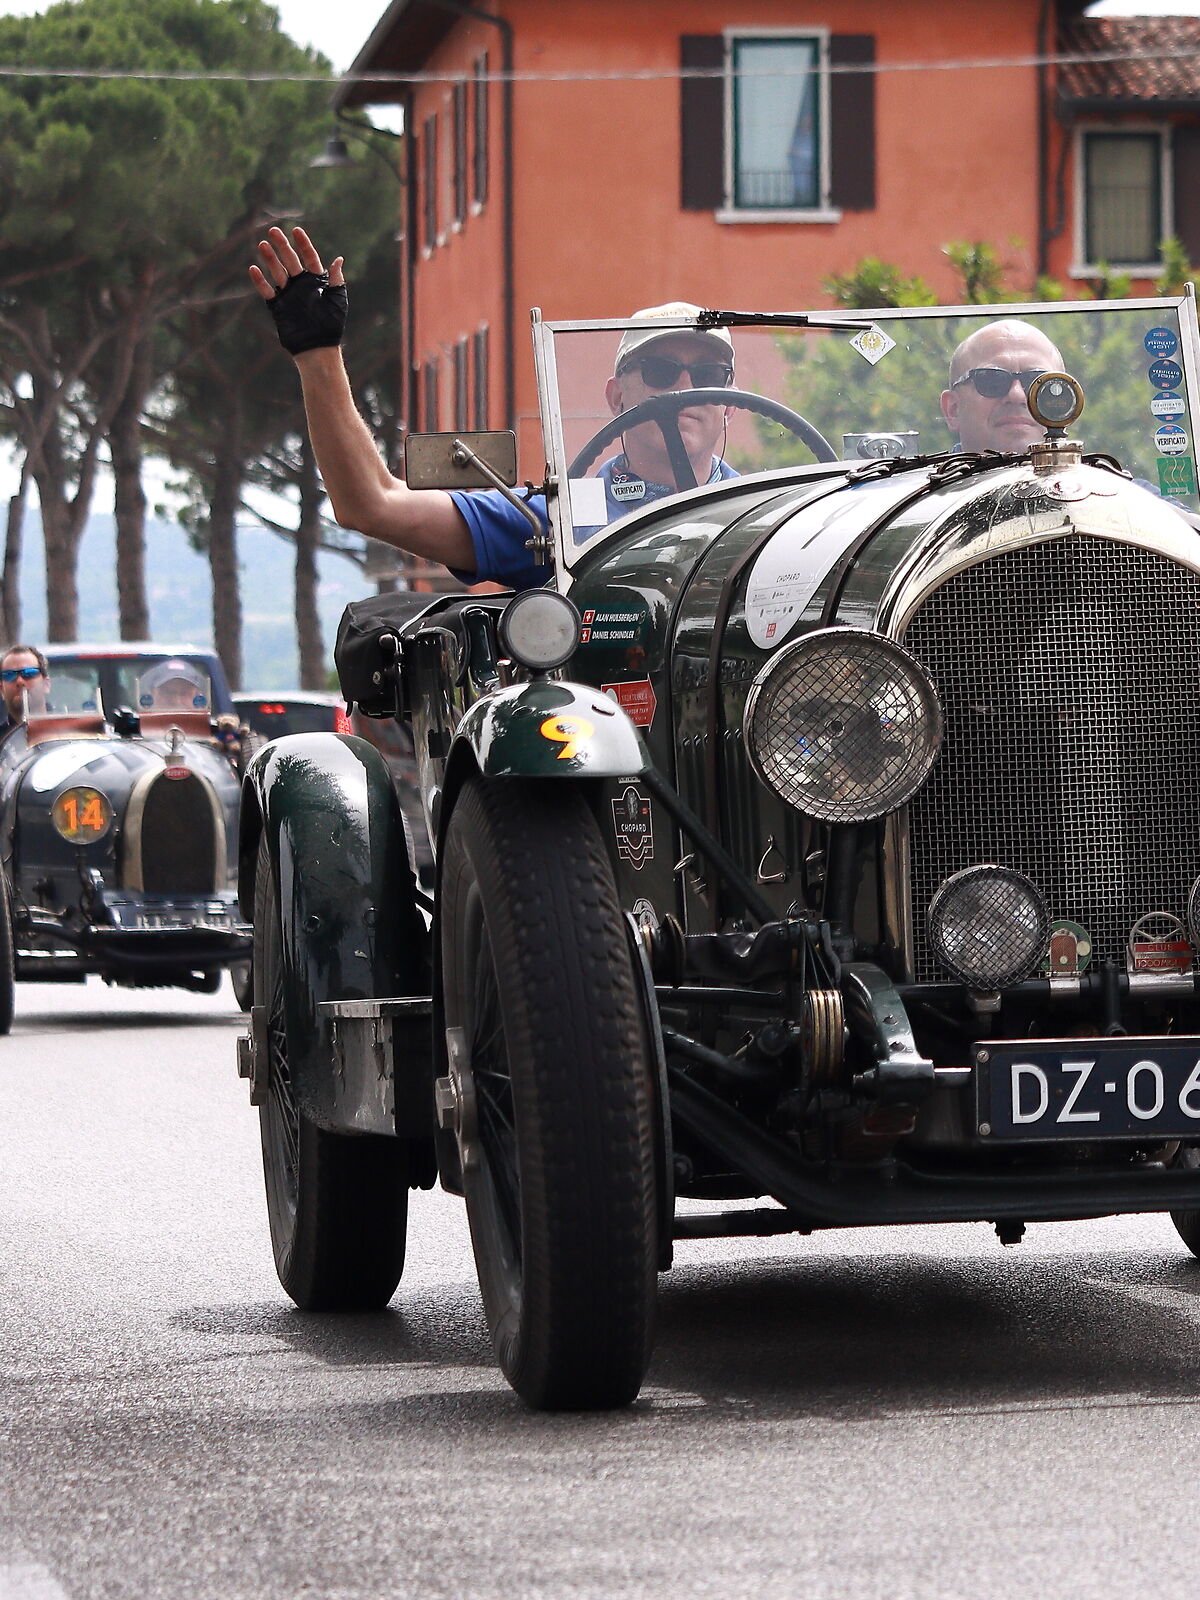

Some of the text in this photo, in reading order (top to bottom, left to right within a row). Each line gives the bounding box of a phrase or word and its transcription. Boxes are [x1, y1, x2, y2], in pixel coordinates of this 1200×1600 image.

[1157, 437, 1186, 446] VERIFICATO
[613, 484, 644, 496] VERIFICATO
[775, 571, 801, 584] CHOPARD
[595, 613, 610, 622] ALAN
[592, 630, 609, 640] DANIEL
[609, 630, 634, 640] SCHINDLER
[540, 715, 595, 760] 9
[64, 799, 104, 831] 14
[620, 823, 647, 833] CHOPARD
[1147, 944, 1172, 952] CLUB
